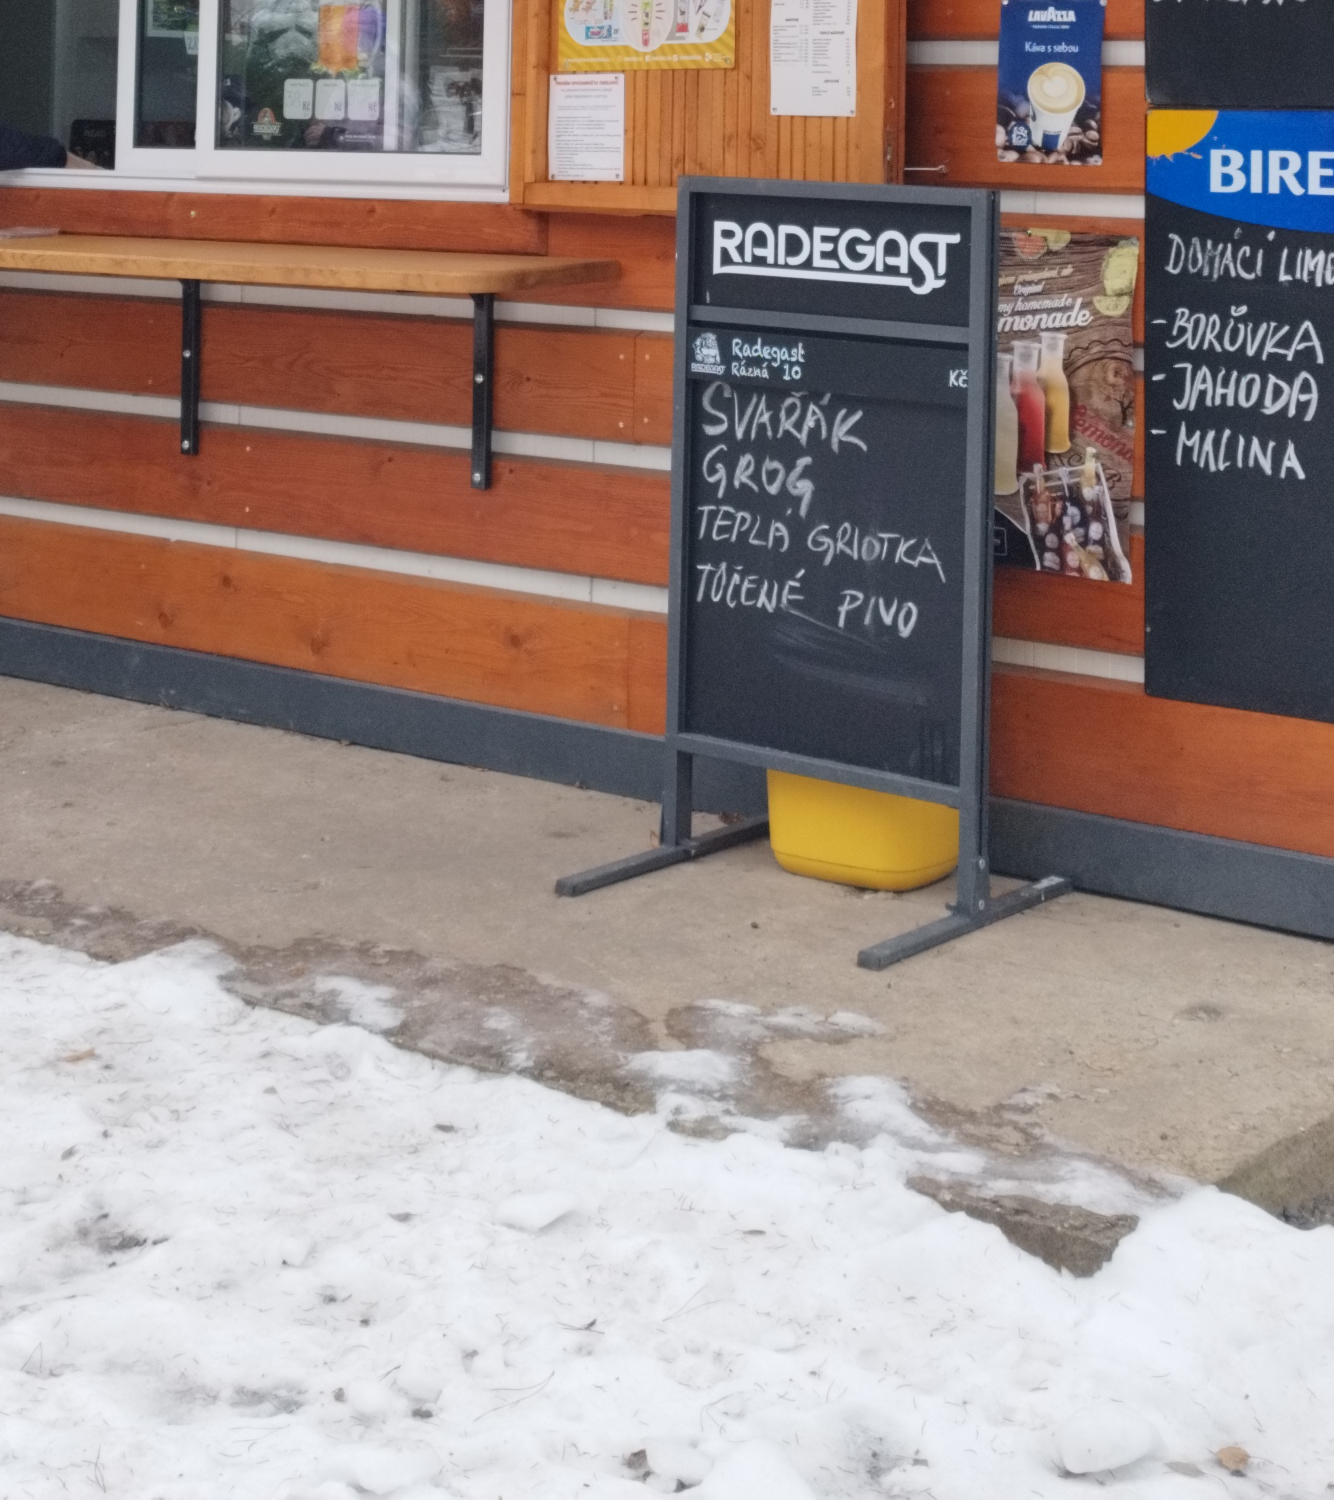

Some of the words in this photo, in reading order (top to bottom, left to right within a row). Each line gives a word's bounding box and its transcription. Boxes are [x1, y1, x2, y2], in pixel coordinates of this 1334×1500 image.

[1027, 6, 1077, 22] LAVAZZA
[1024, 41, 1046, 53] Káva
[1053, 42, 1079, 53] sebou
[711, 219, 962, 295] RADEGAST
[1164, 226, 1276, 282] DOMÁCÍ
[997, 297, 1095, 333] monade
[1014, 293, 1073, 312] homemade
[731, 337, 805, 367] Radegast
[731, 358, 769, 380] Rázná
[782, 363, 802, 381] 10
[948, 368, 969, 388] Kč
[701, 380, 868, 455] SVAŘÁK
[702, 443, 816, 520] GROG
[697, 505, 793, 553] TEPLÁ
[807, 521, 947, 584] GRIOTKA
[696, 561, 806, 613] TOČENÉ
[837, 589, 918, 639] PIVO
